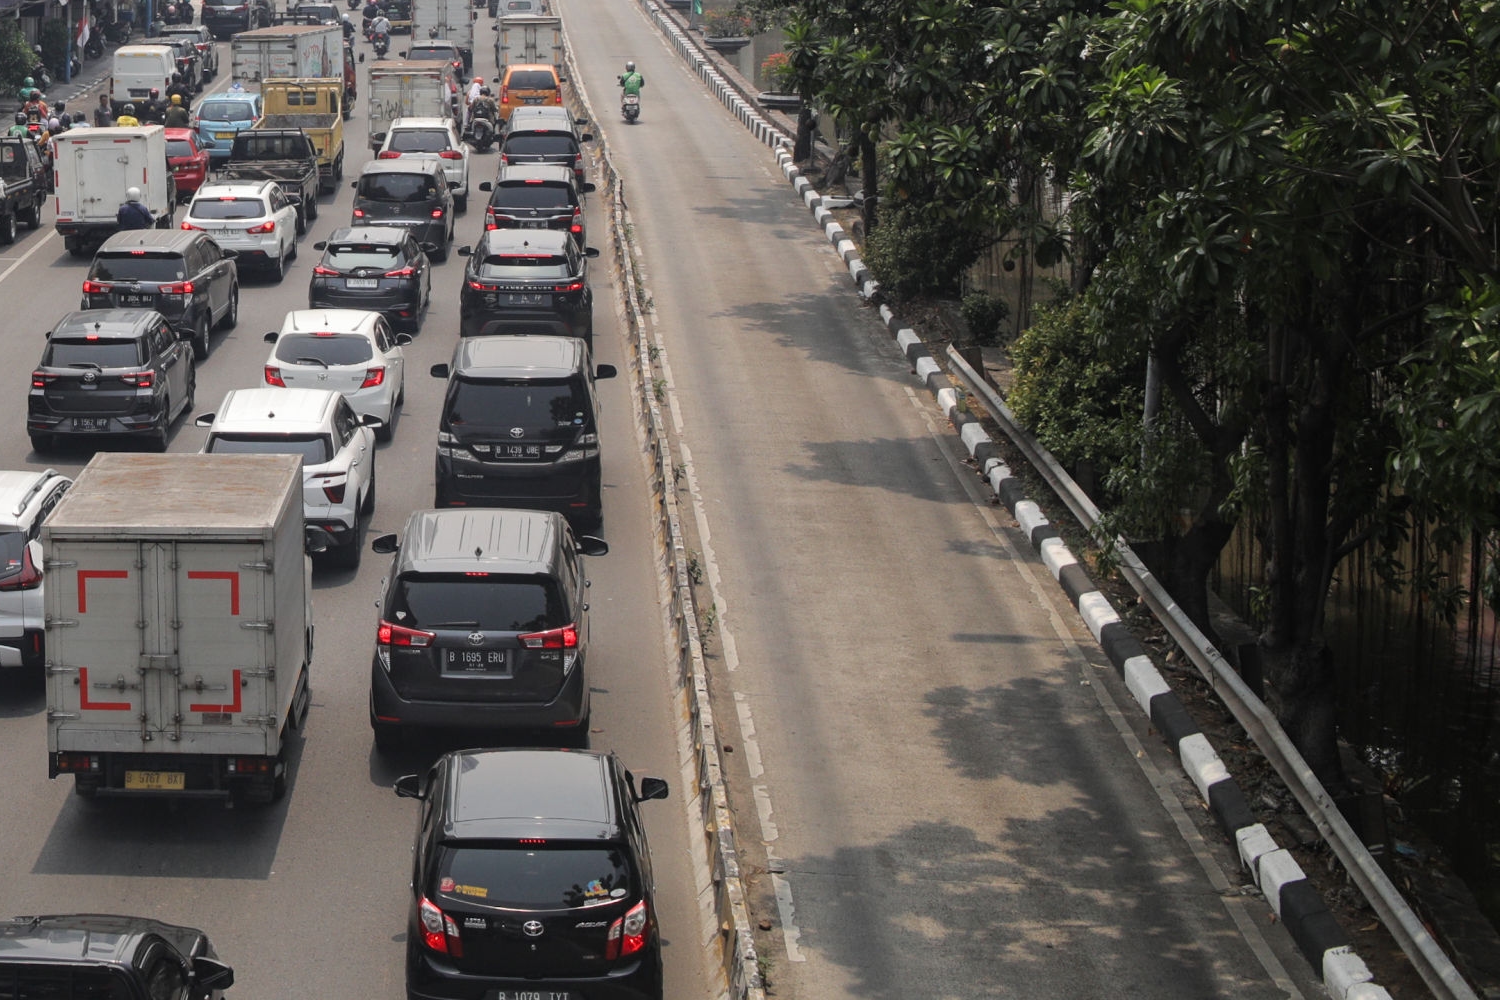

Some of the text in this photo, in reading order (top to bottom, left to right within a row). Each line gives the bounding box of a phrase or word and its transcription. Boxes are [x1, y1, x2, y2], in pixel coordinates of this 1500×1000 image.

[449, 652, 504, 662] B 1695 ERU
